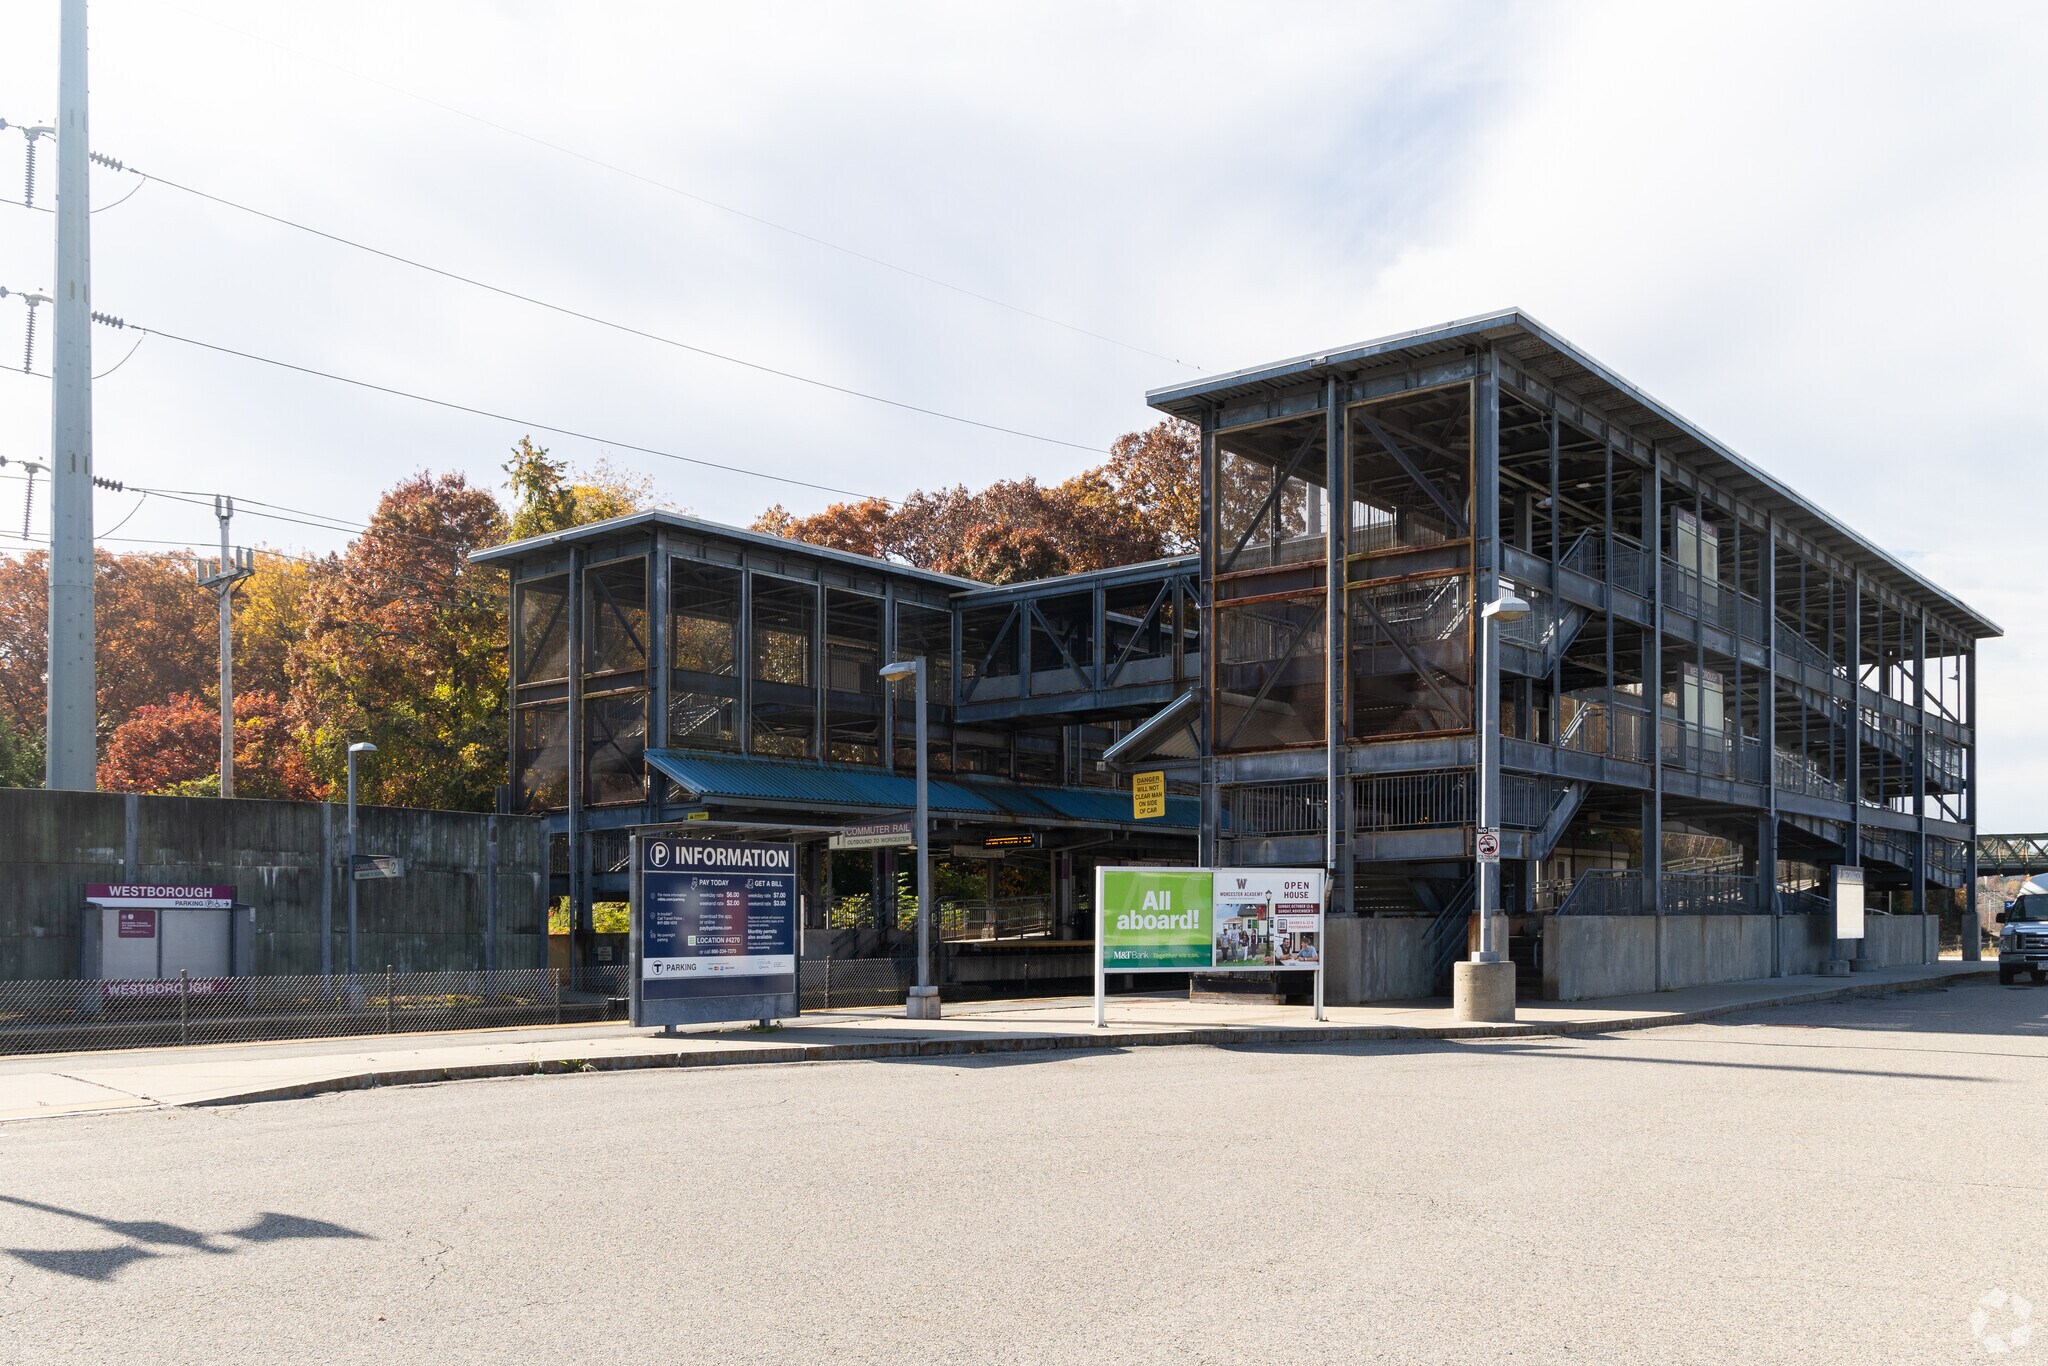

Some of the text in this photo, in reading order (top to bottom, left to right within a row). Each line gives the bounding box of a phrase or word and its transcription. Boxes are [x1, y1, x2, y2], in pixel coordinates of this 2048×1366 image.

[1137, 776, 1160, 784] DANGER
[847, 824, 910, 836] COMMUTER RAIL
[655, 845, 789, 867] P INFORMATION
[391, 862, 396, 874] 2
[1236, 878, 1247, 889] W
[1284, 881, 1310, 889] OPEN
[109, 886, 213, 898] WESTBOROUGH
[1142, 890, 1171, 910] All
[1116, 909, 1199, 930] aboard!
[1114, 951, 1149, 959] M&T Bank
[654, 963, 661, 973] T
[666, 963, 697, 971] PARKING
